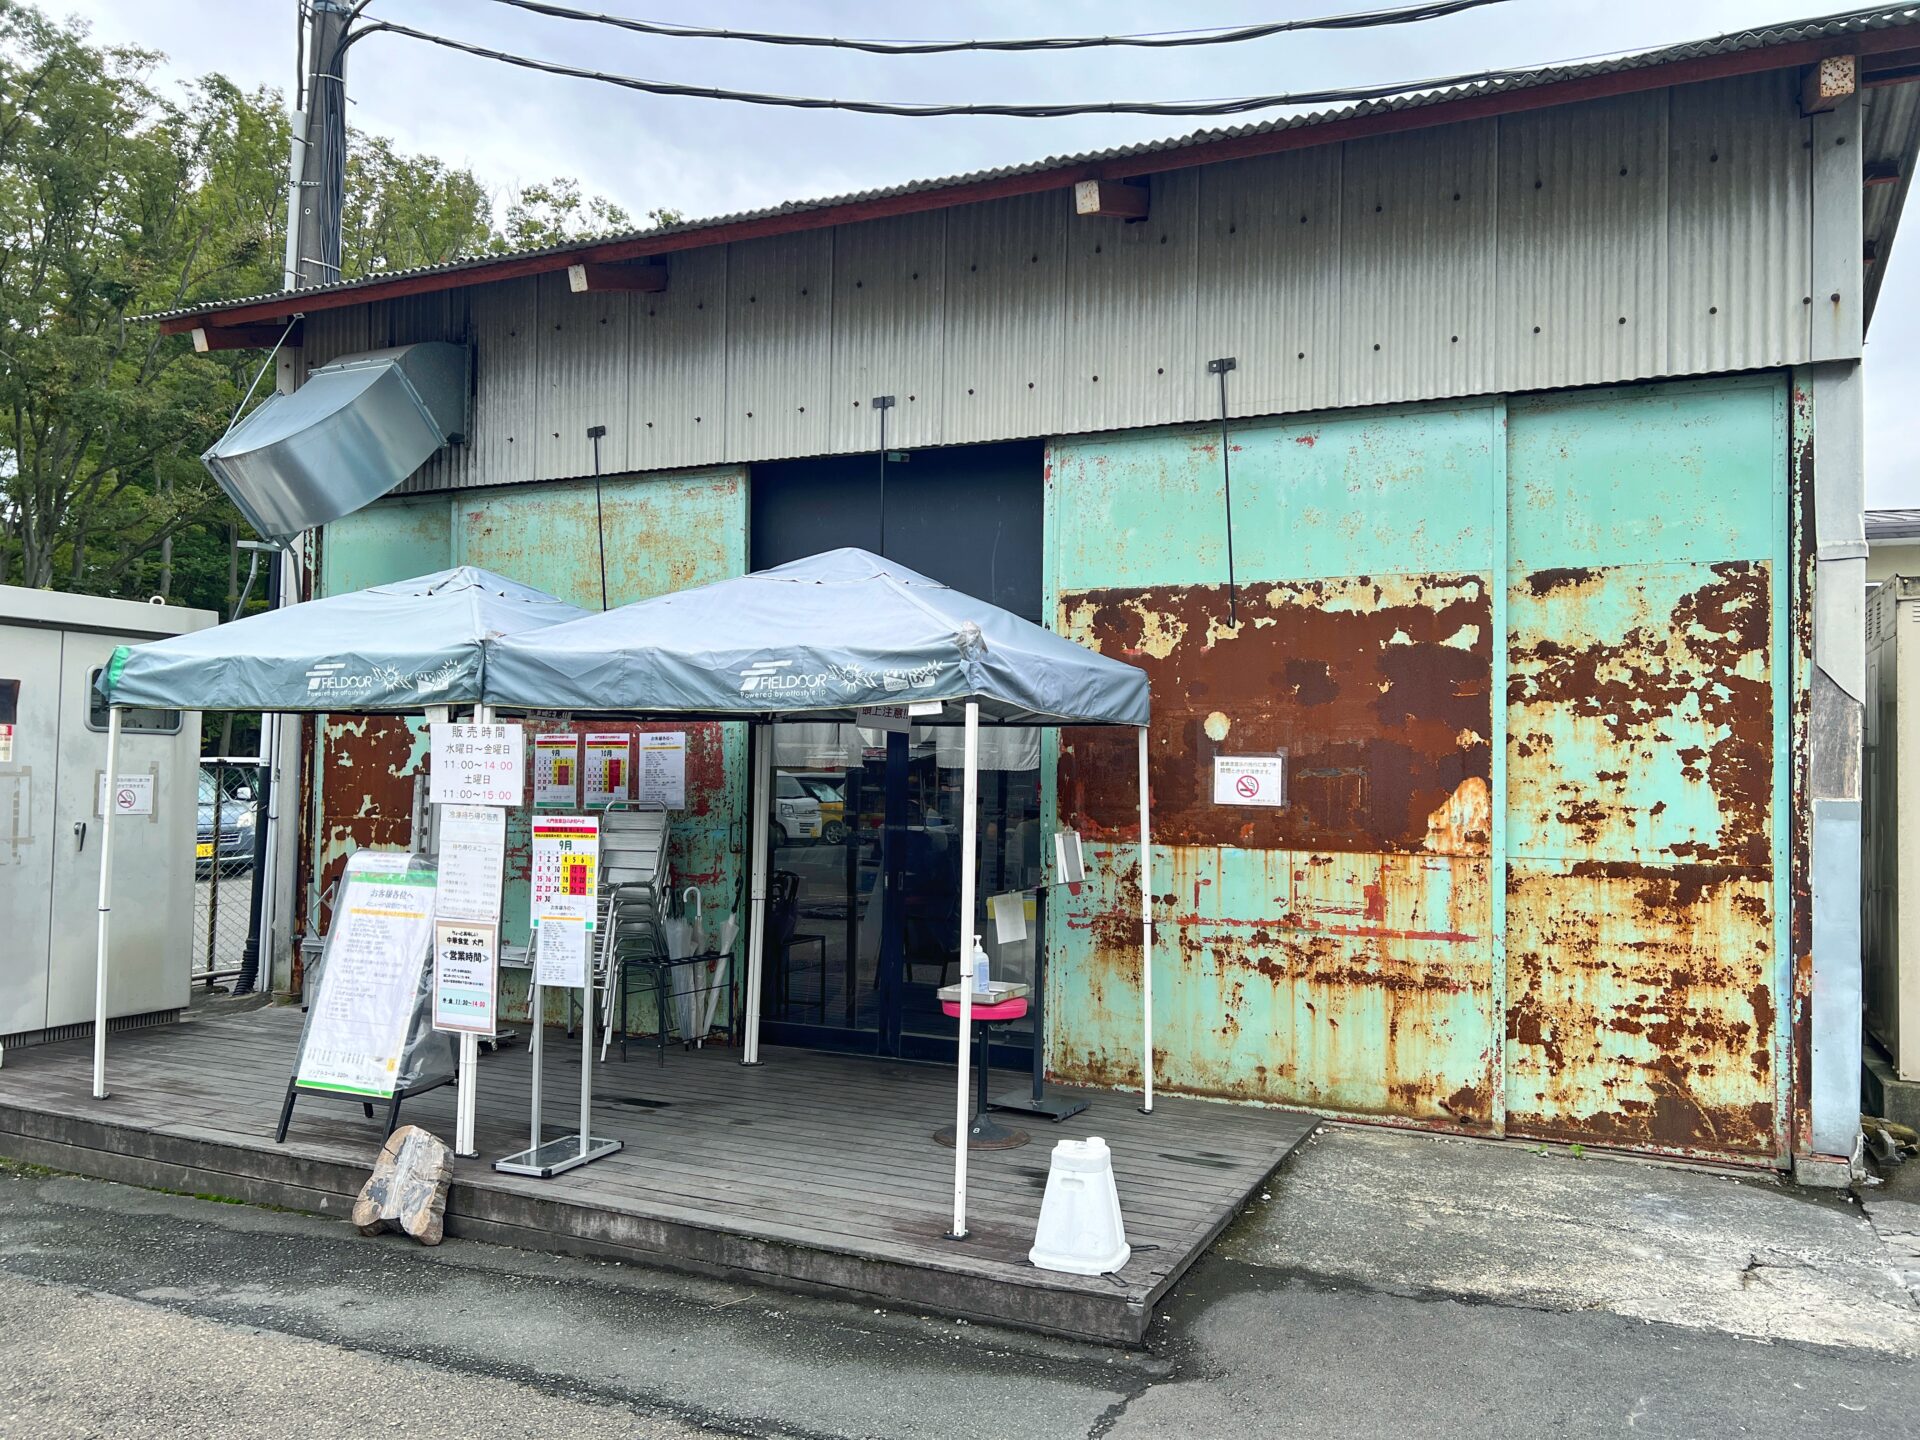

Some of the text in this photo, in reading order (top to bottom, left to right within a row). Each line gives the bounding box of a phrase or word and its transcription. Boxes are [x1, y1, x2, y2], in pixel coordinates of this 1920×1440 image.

[321, 675, 373, 689] FIELDOOR
[760, 673, 826, 690] FIELDOOR
[740, 691, 773, 699] Powered
[774, 690, 784, 699] by
[451, 725, 506, 739] 販売時間
[464, 774, 491, 785] 土曜日
[559, 840, 572, 850] 9月
[446, 937, 469, 946] 中華食堂
